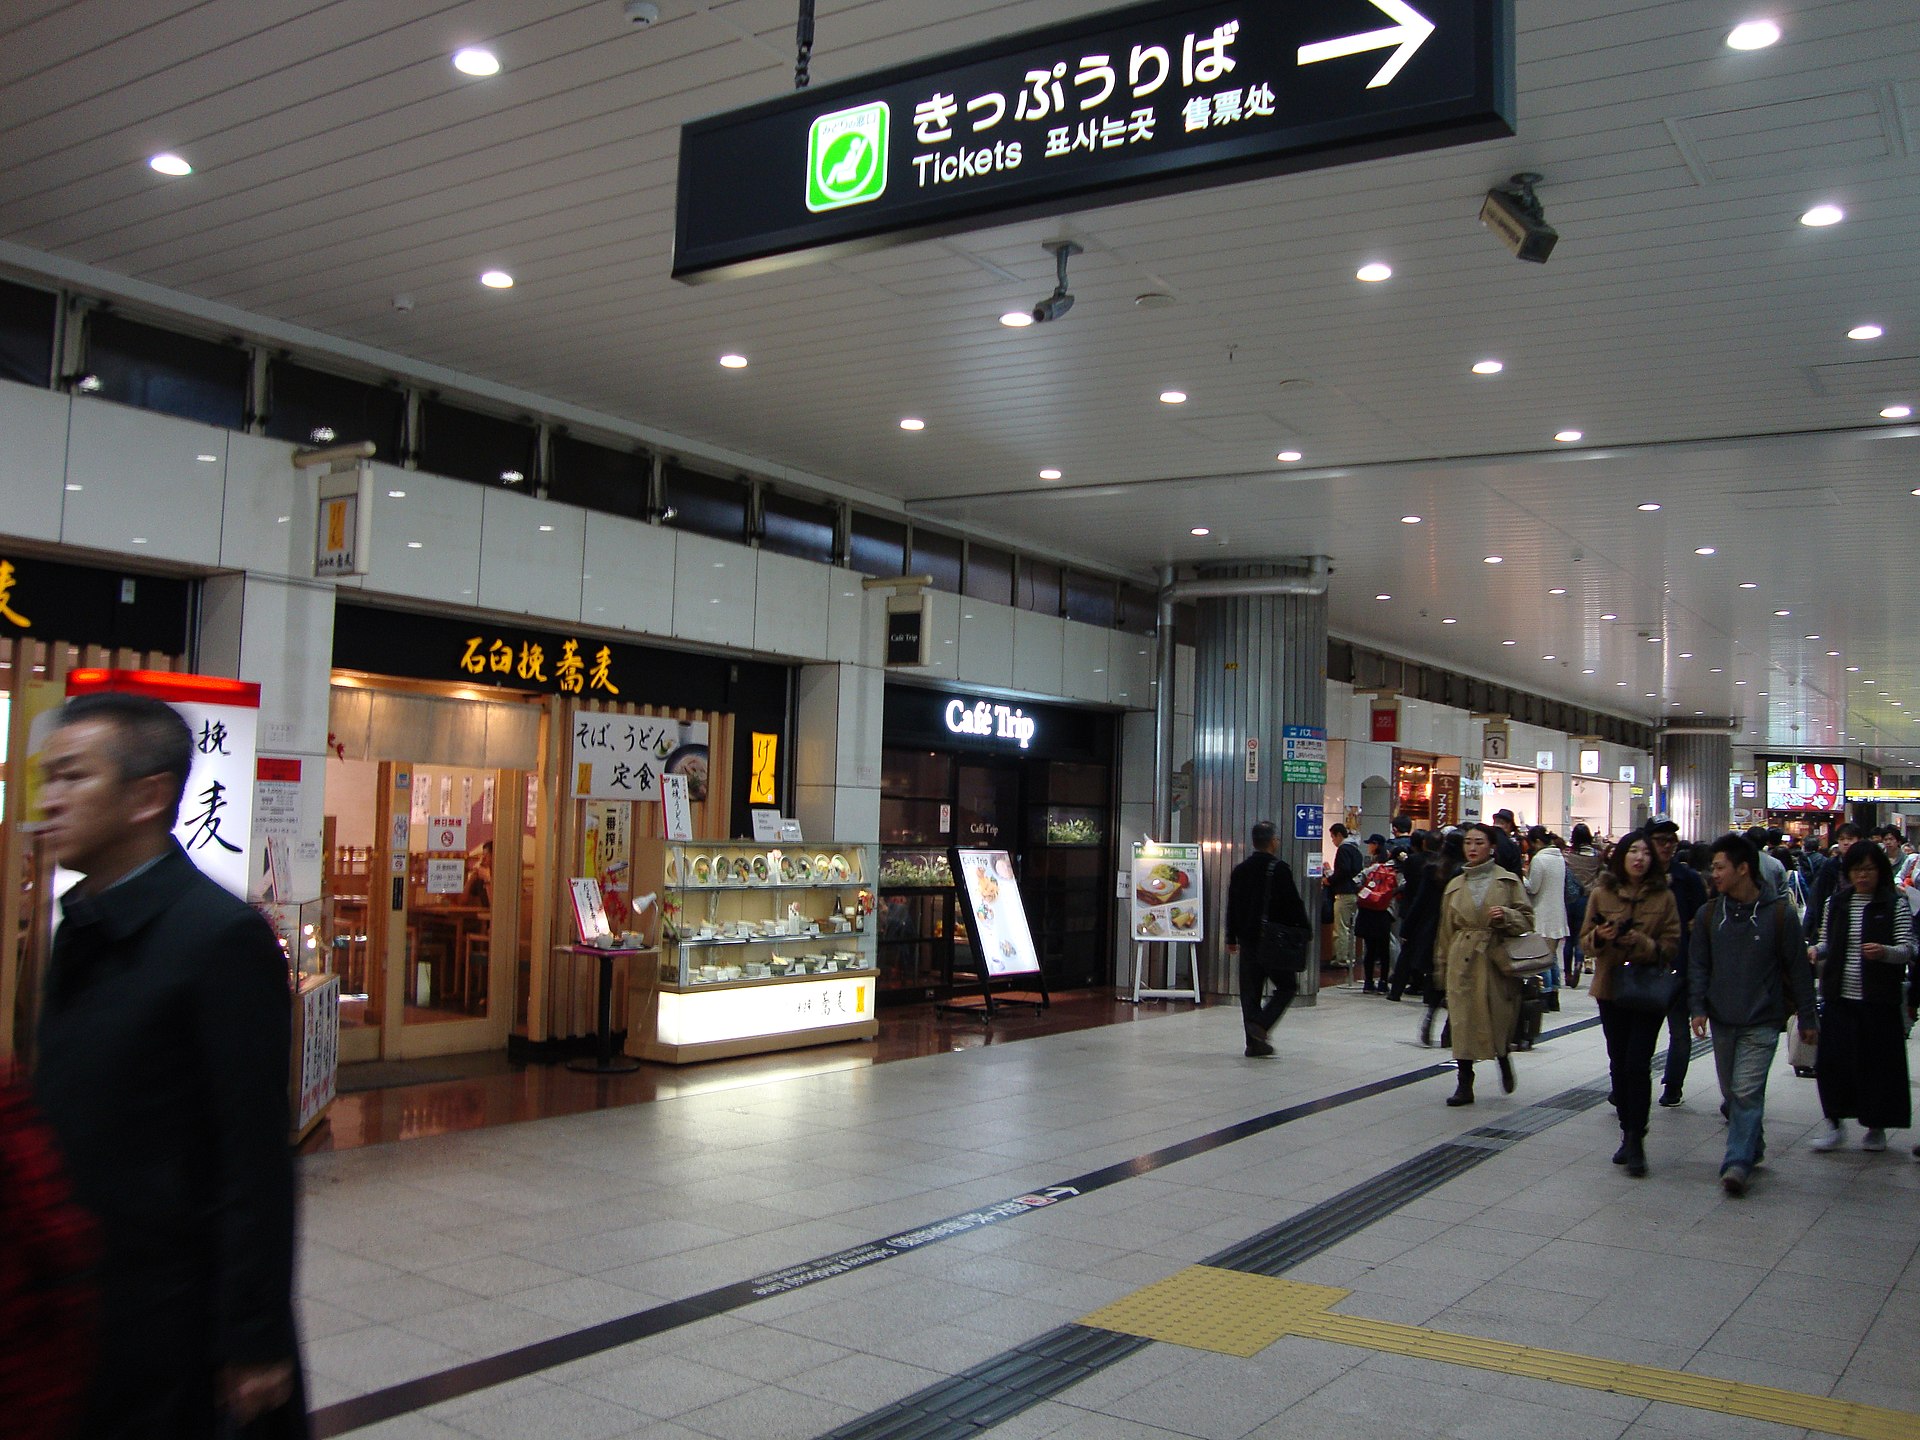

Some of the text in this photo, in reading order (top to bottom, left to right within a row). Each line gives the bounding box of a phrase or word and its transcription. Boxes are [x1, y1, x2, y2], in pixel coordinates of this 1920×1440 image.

[912, 20, 1239, 144] きっぷうりば
[1044, 106, 1157, 158] 표사는곳
[1181, 82, 1276, 133] 售票处
[911, 140, 1023, 188] Tickets
[460, 636, 619, 695] 石臼挽蕎麦
[576, 722, 667, 752] そば、うどん
[945, 699, 1035, 749] Café Trip
[611, 761, 655, 792] 定食
[184, 780, 243, 853] 麦
[970, 822, 998, 836] Café Trip
[1437, 793, 1447, 828] マネケン
